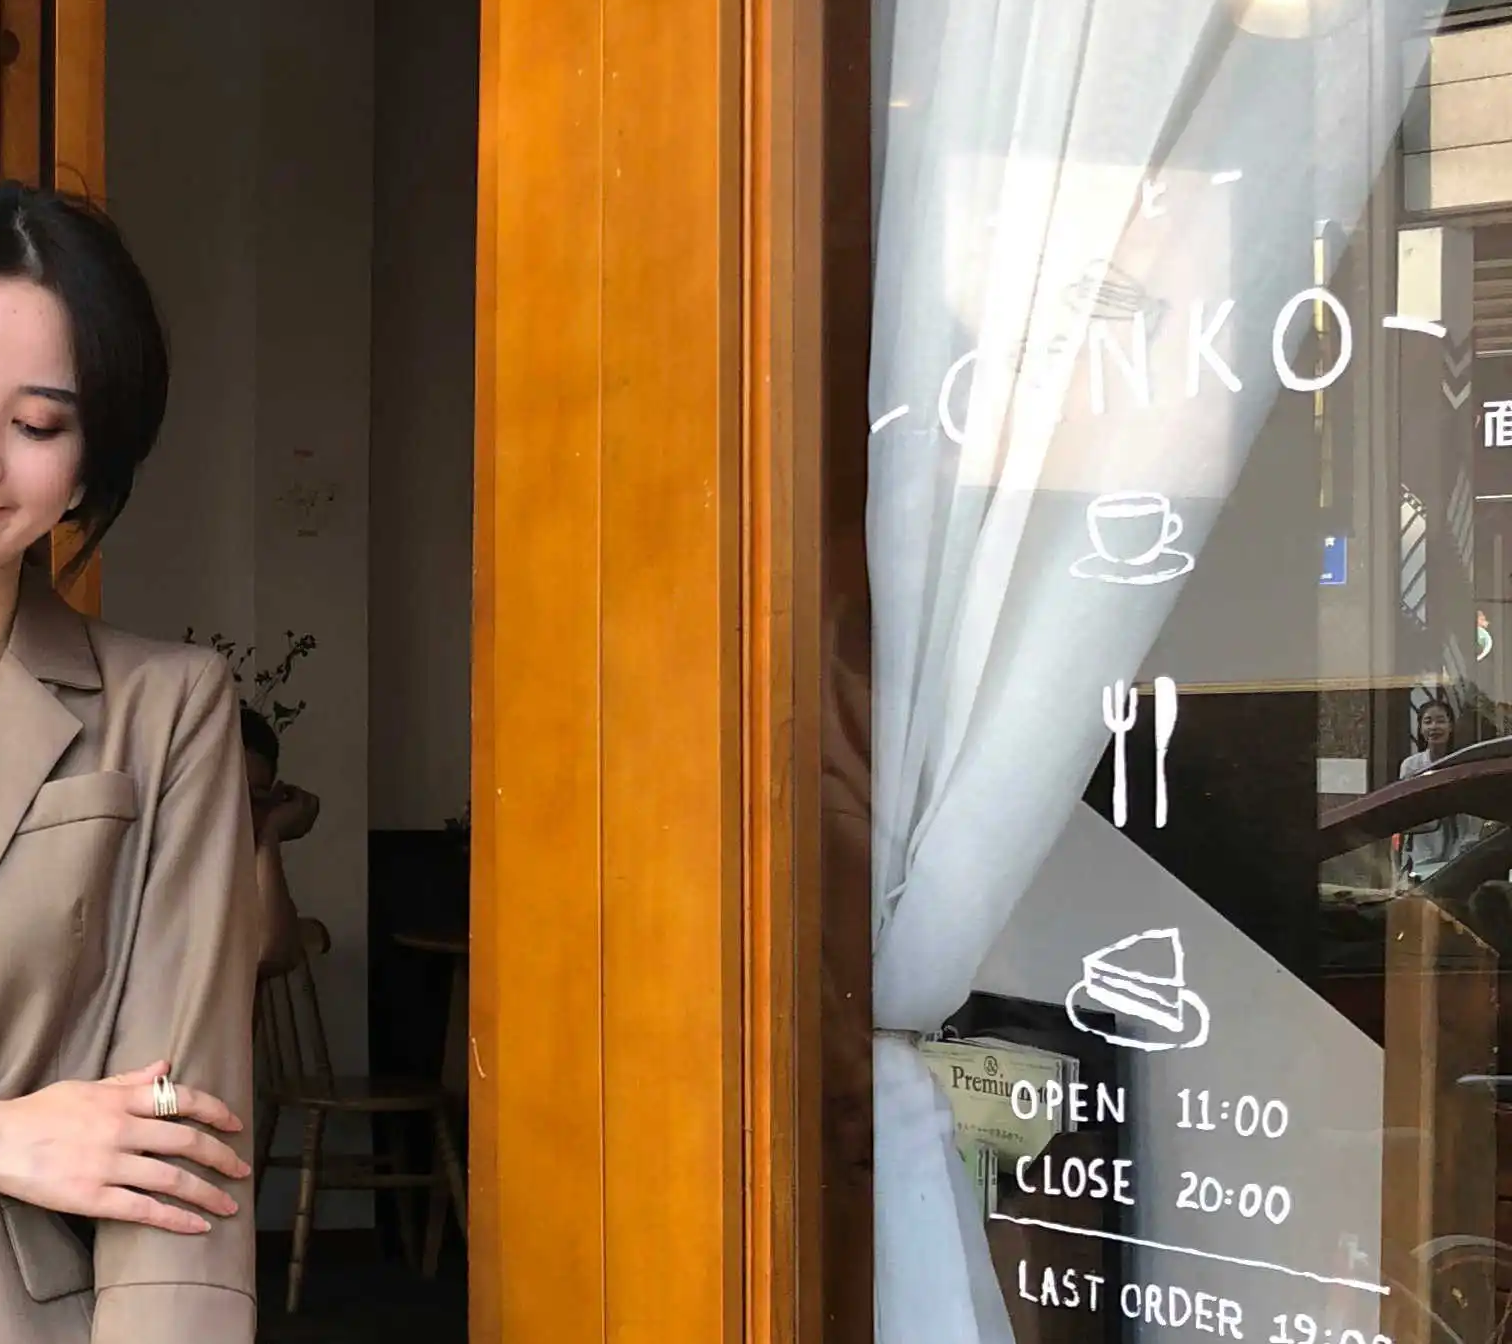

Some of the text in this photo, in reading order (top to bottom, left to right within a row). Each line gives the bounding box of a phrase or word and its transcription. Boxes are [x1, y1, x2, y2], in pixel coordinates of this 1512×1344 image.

[1010, 1078, 1125, 1124] OPEN
[1176, 1087, 1289, 1139] 11:00
[1015, 1154, 1135, 1206] CLOSE
[1175, 1170, 1292, 1226] 20:00
[1018, 1259, 1105, 1311] LAST
[1120, 1283, 1245, 1341] ORDER
